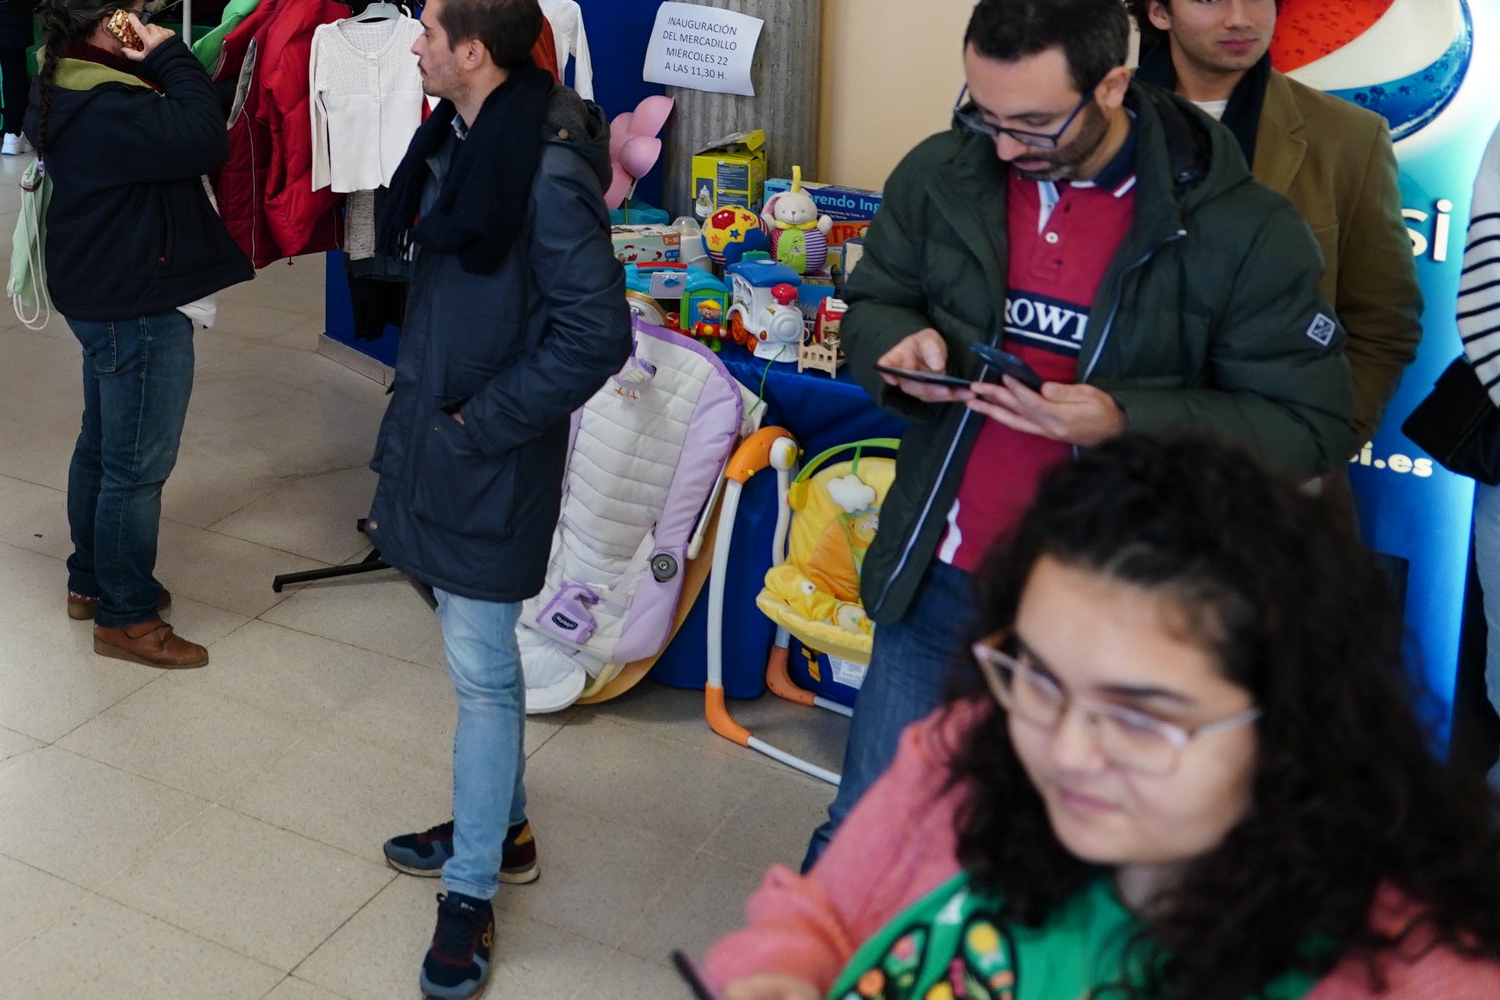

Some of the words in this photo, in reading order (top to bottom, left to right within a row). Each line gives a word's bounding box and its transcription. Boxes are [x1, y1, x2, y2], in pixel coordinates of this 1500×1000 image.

[668, 17, 738, 35] INAUGURACIÓN
[662, 31, 679, 41] DEL
[680, 33, 737, 50] MERCADILLO
[666, 47, 715, 63] MIÉRCOLES
[717, 56, 728, 66] 22
[665, 62, 671, 70] A
[673, 63, 689, 73] LAS
[691, 66, 715, 79] 11,30
[717, 71, 727, 80] H.
[1349, 440, 1433, 478] i.es
